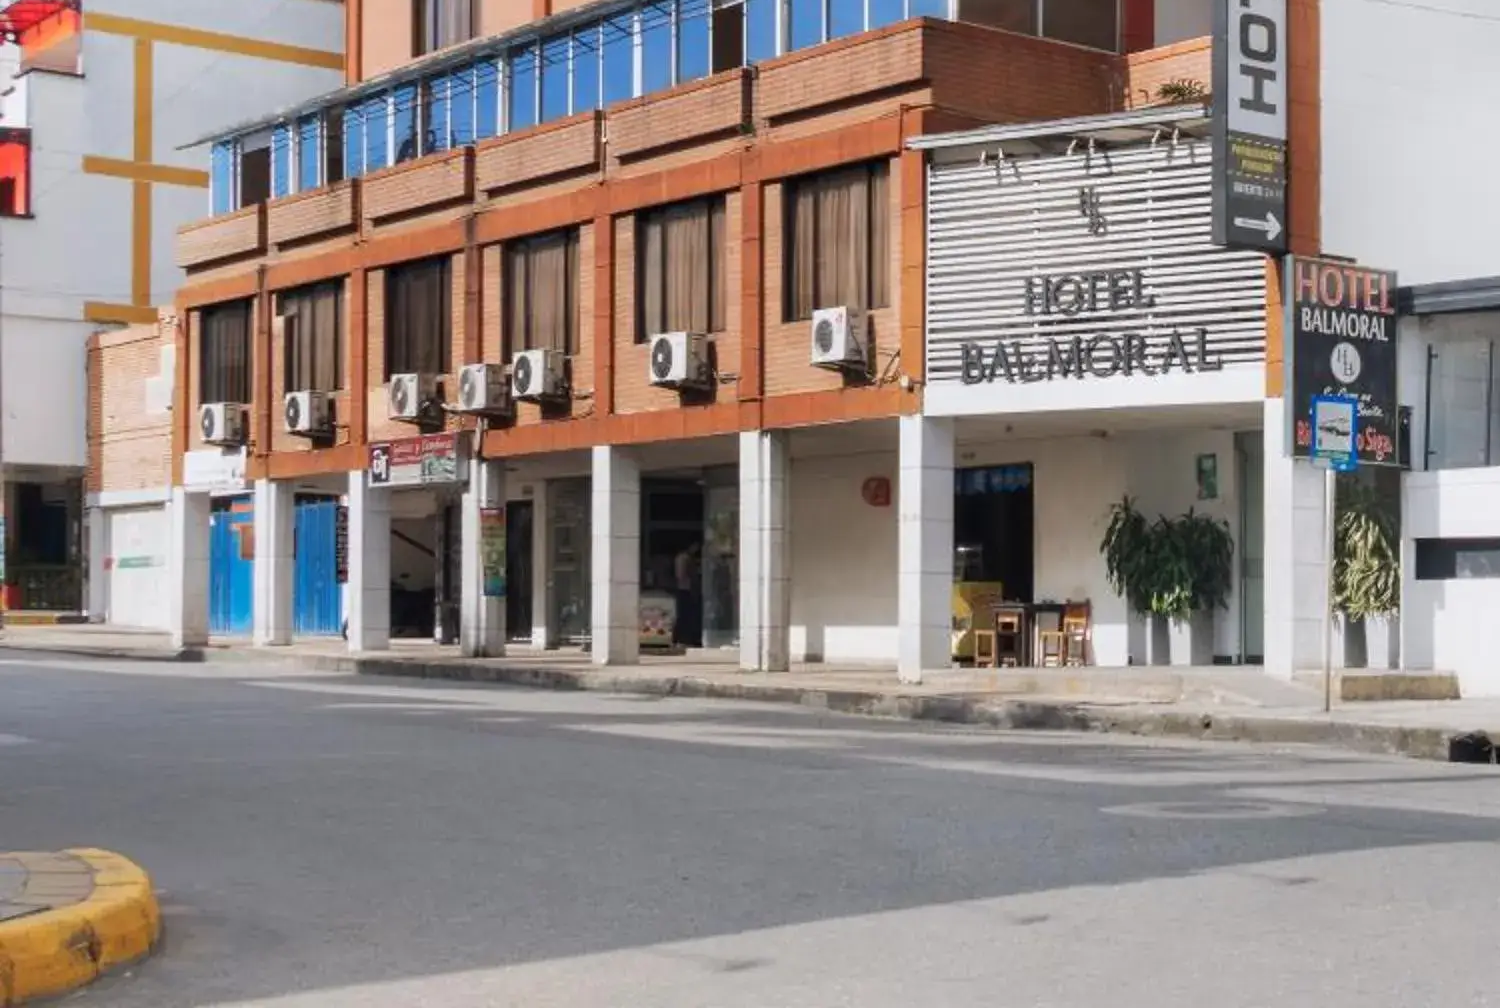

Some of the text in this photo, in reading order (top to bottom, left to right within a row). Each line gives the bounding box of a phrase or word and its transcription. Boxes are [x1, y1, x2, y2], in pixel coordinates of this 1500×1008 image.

[1023, 268, 1157, 316] HOTEL
[1295, 261, 1396, 316] HOTEL
[1301, 307, 1389, 341] BALMORAL
[960, 327, 1223, 385] BALMORAL
